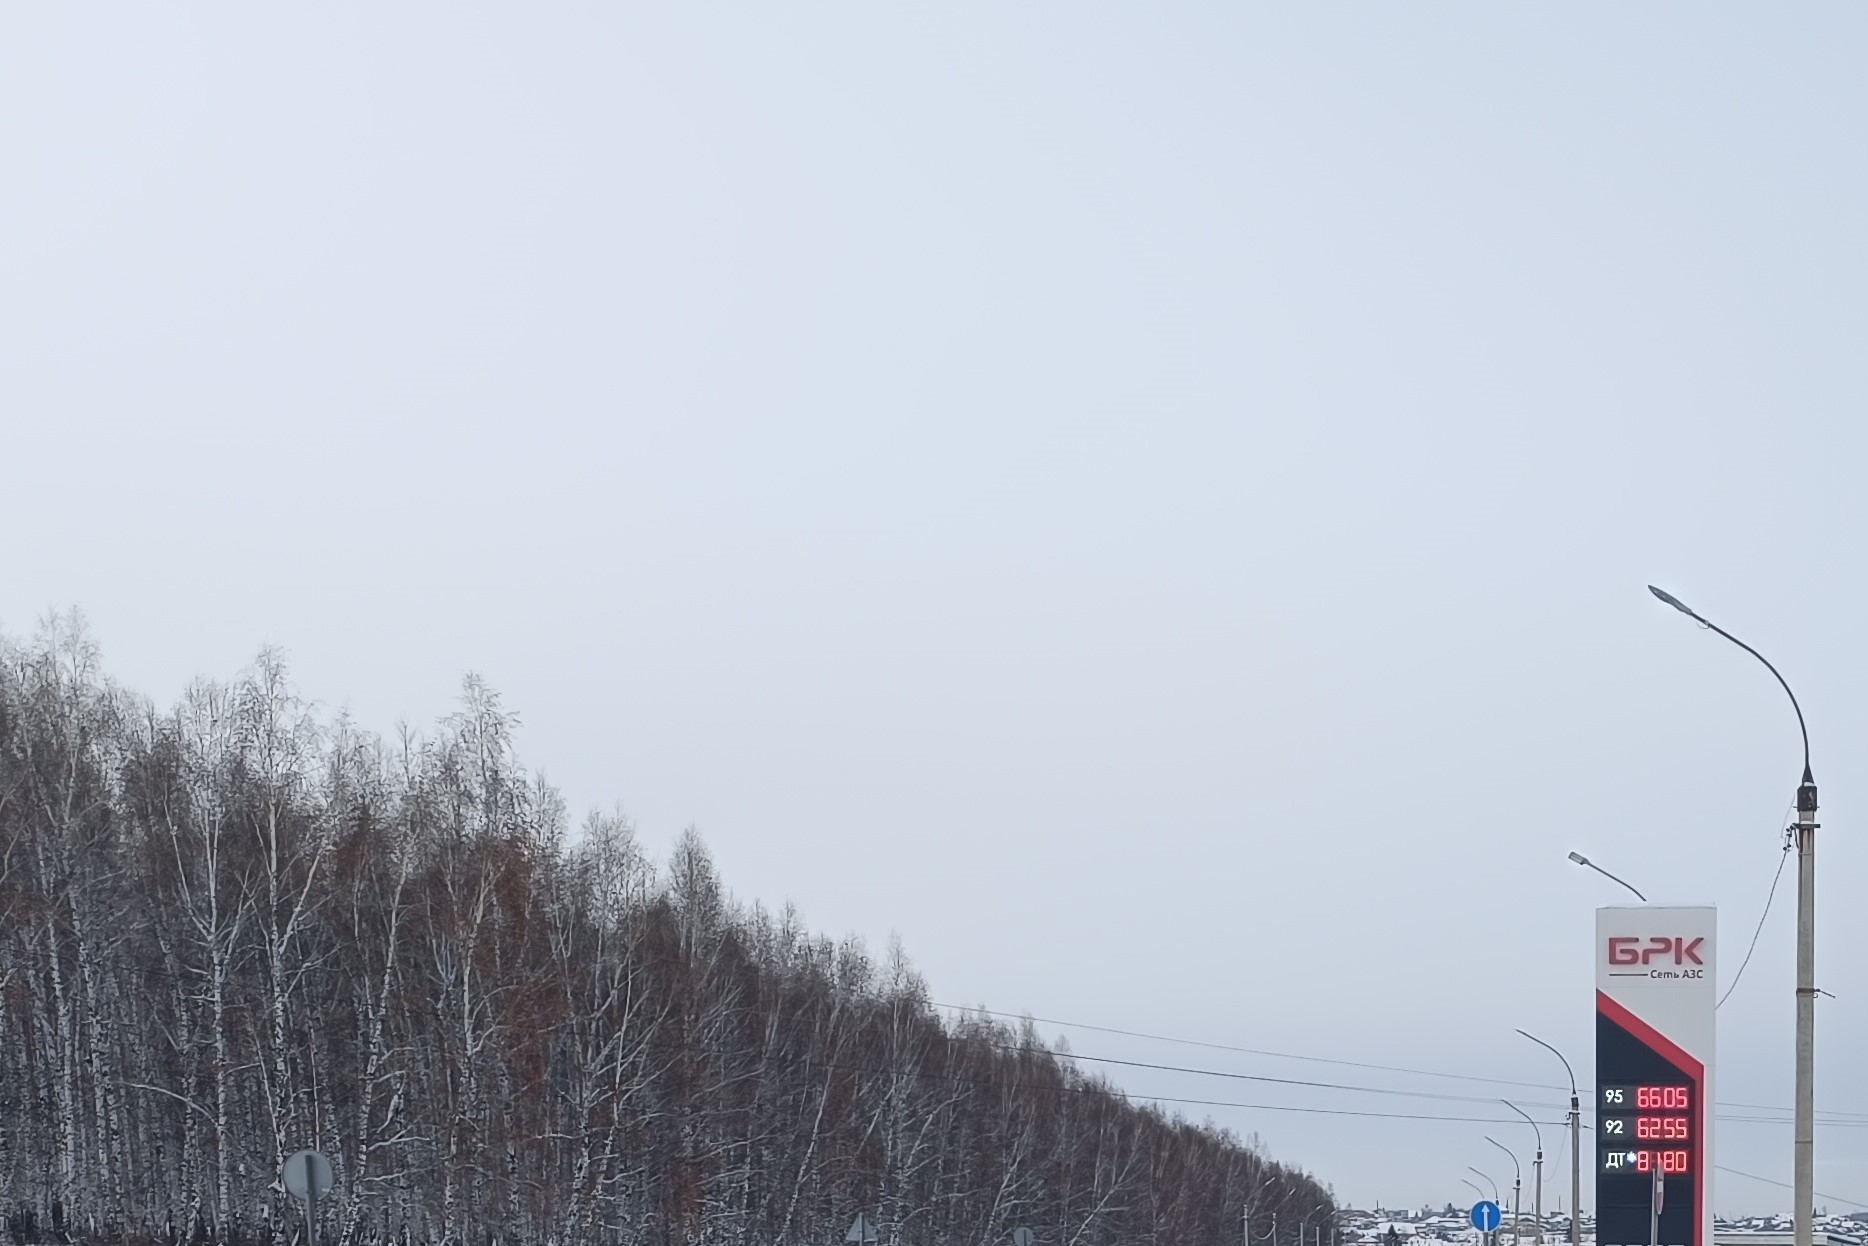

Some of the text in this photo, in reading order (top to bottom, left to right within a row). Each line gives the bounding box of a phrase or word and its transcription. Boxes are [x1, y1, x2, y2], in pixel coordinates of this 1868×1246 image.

[1608, 937, 1704, 965] БРК
[1650, 969, 1704, 979] Сеть АЗС
[1605, 1087, 1688, 1108] 95 6605
[1605, 1118, 1687, 1138] 92 6255
[1605, 1151, 1626, 1169] ДТ
